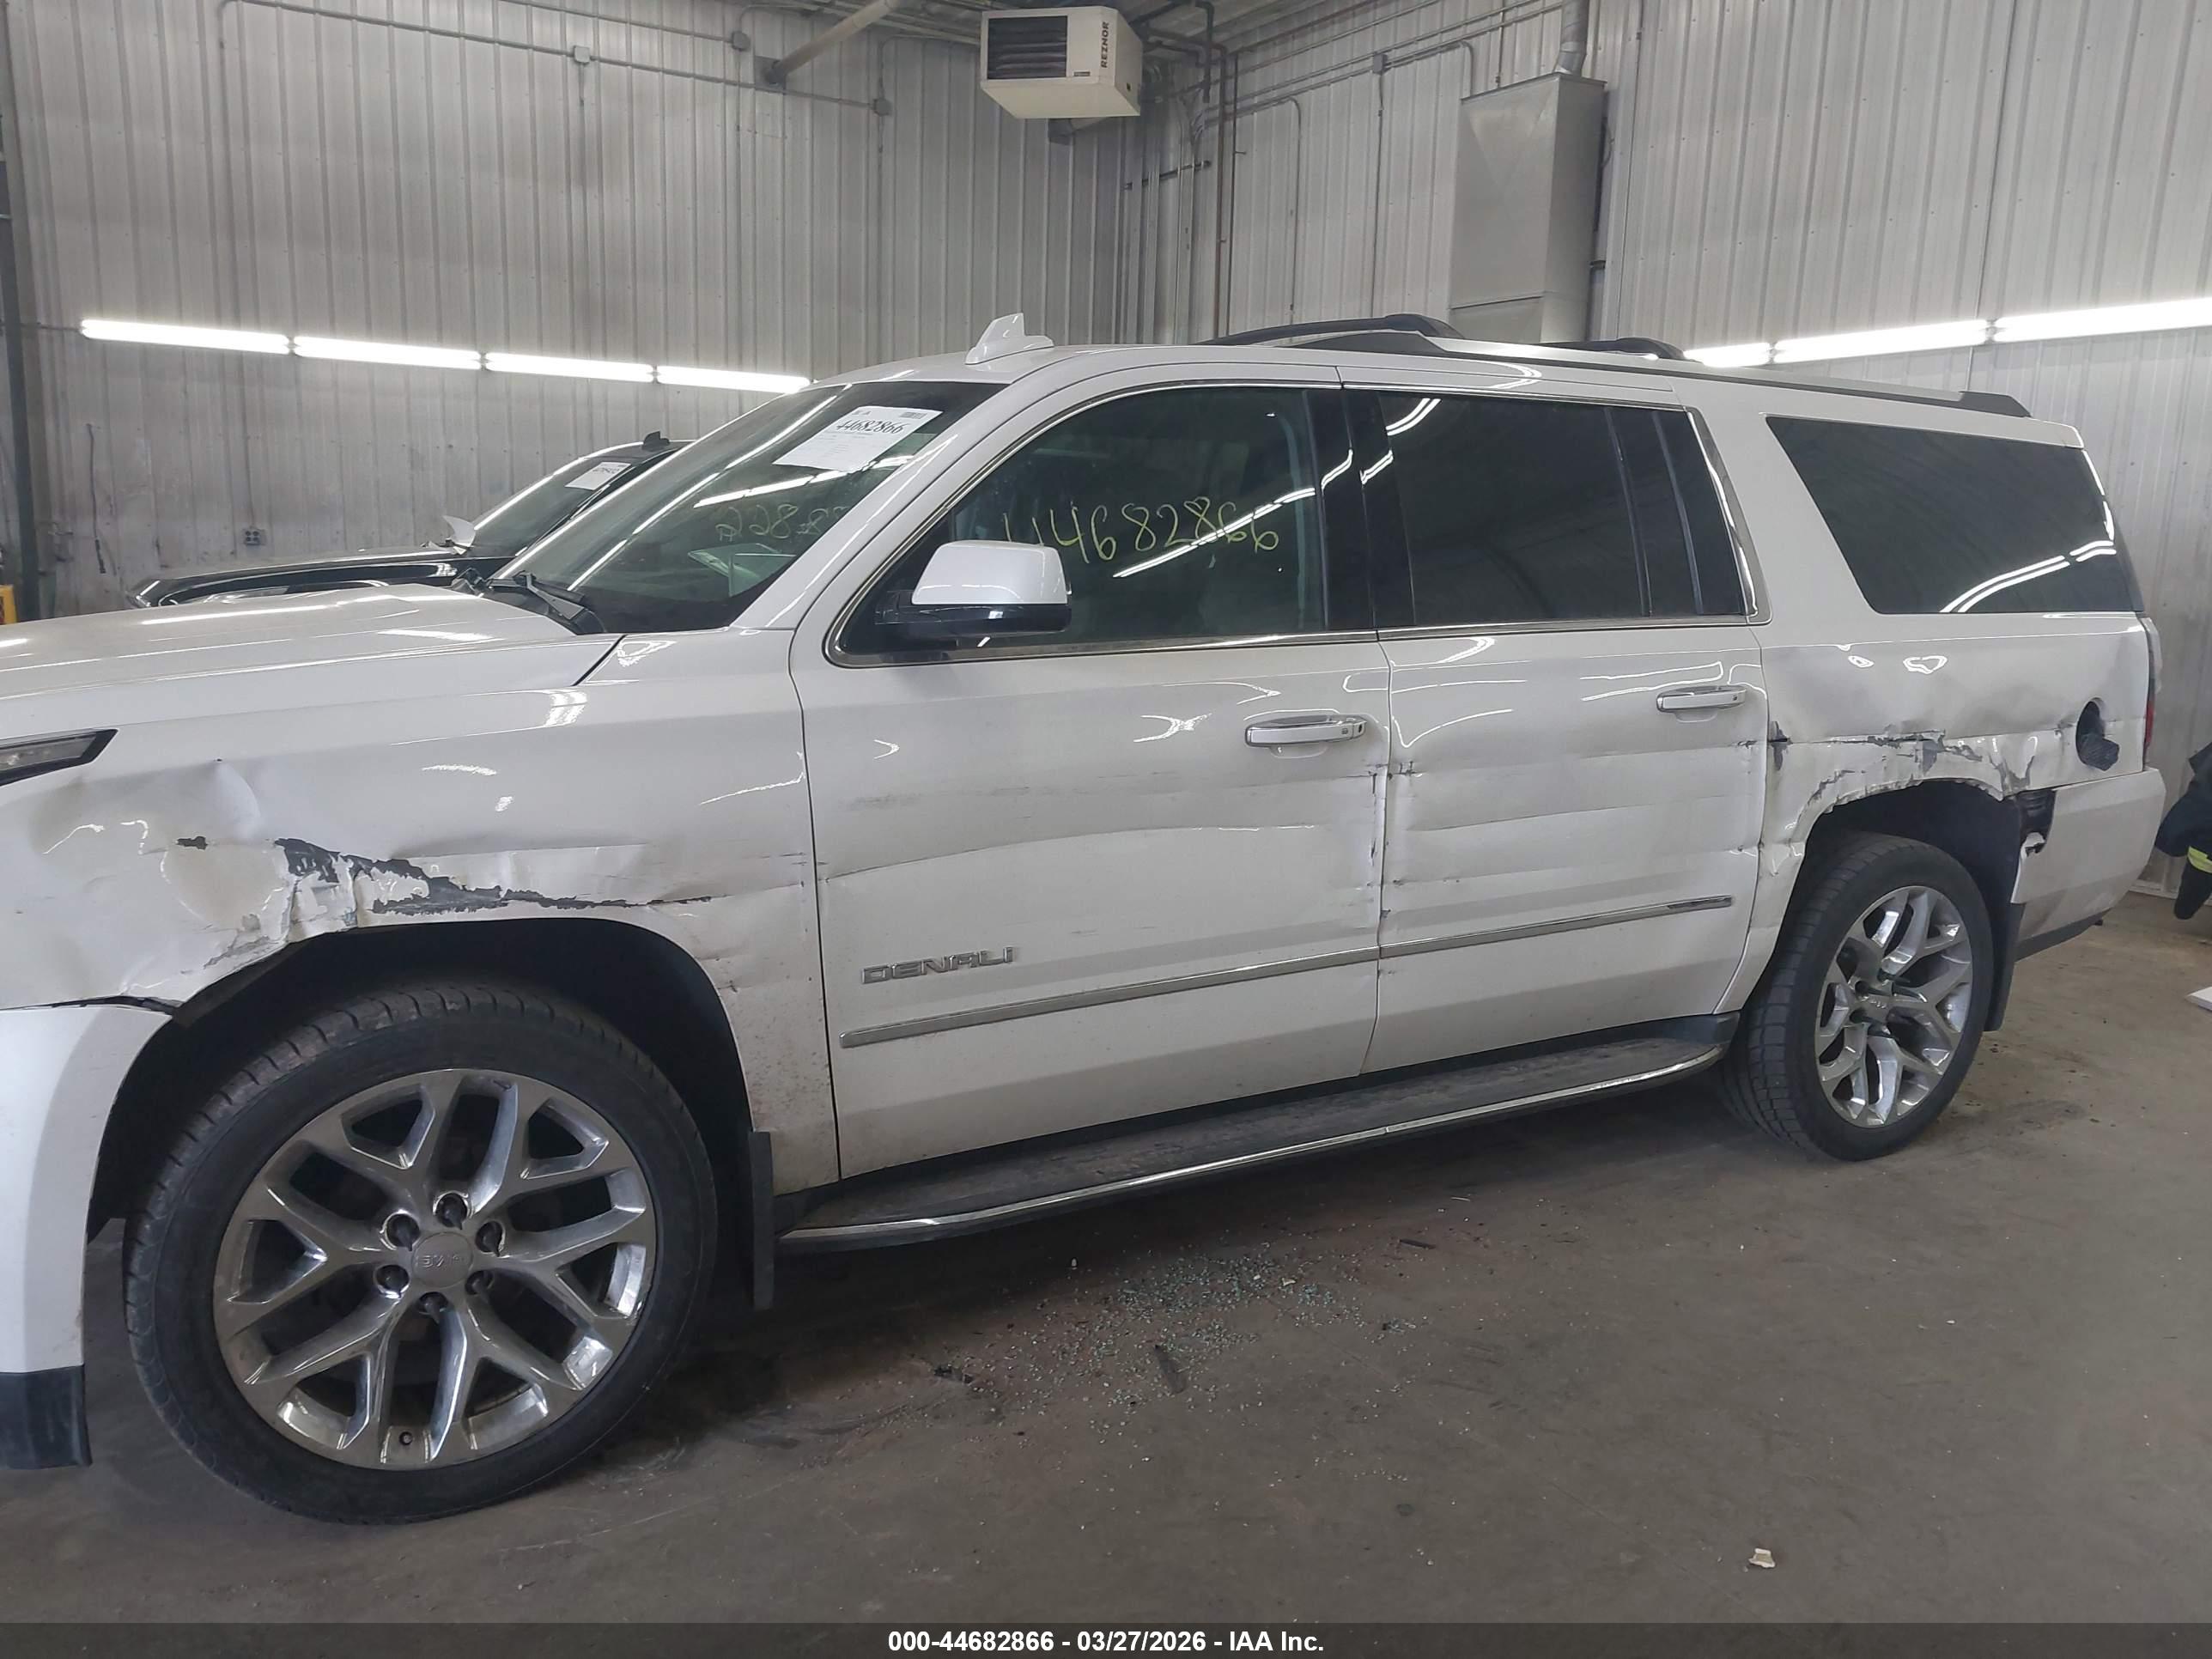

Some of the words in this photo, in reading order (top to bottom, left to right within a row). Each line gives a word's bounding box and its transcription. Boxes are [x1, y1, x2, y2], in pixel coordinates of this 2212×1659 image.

[1101, 21, 1109, 68] REZNOR
[836, 419, 910, 434] 44682866
[861, 946, 1014, 984] DENALI
